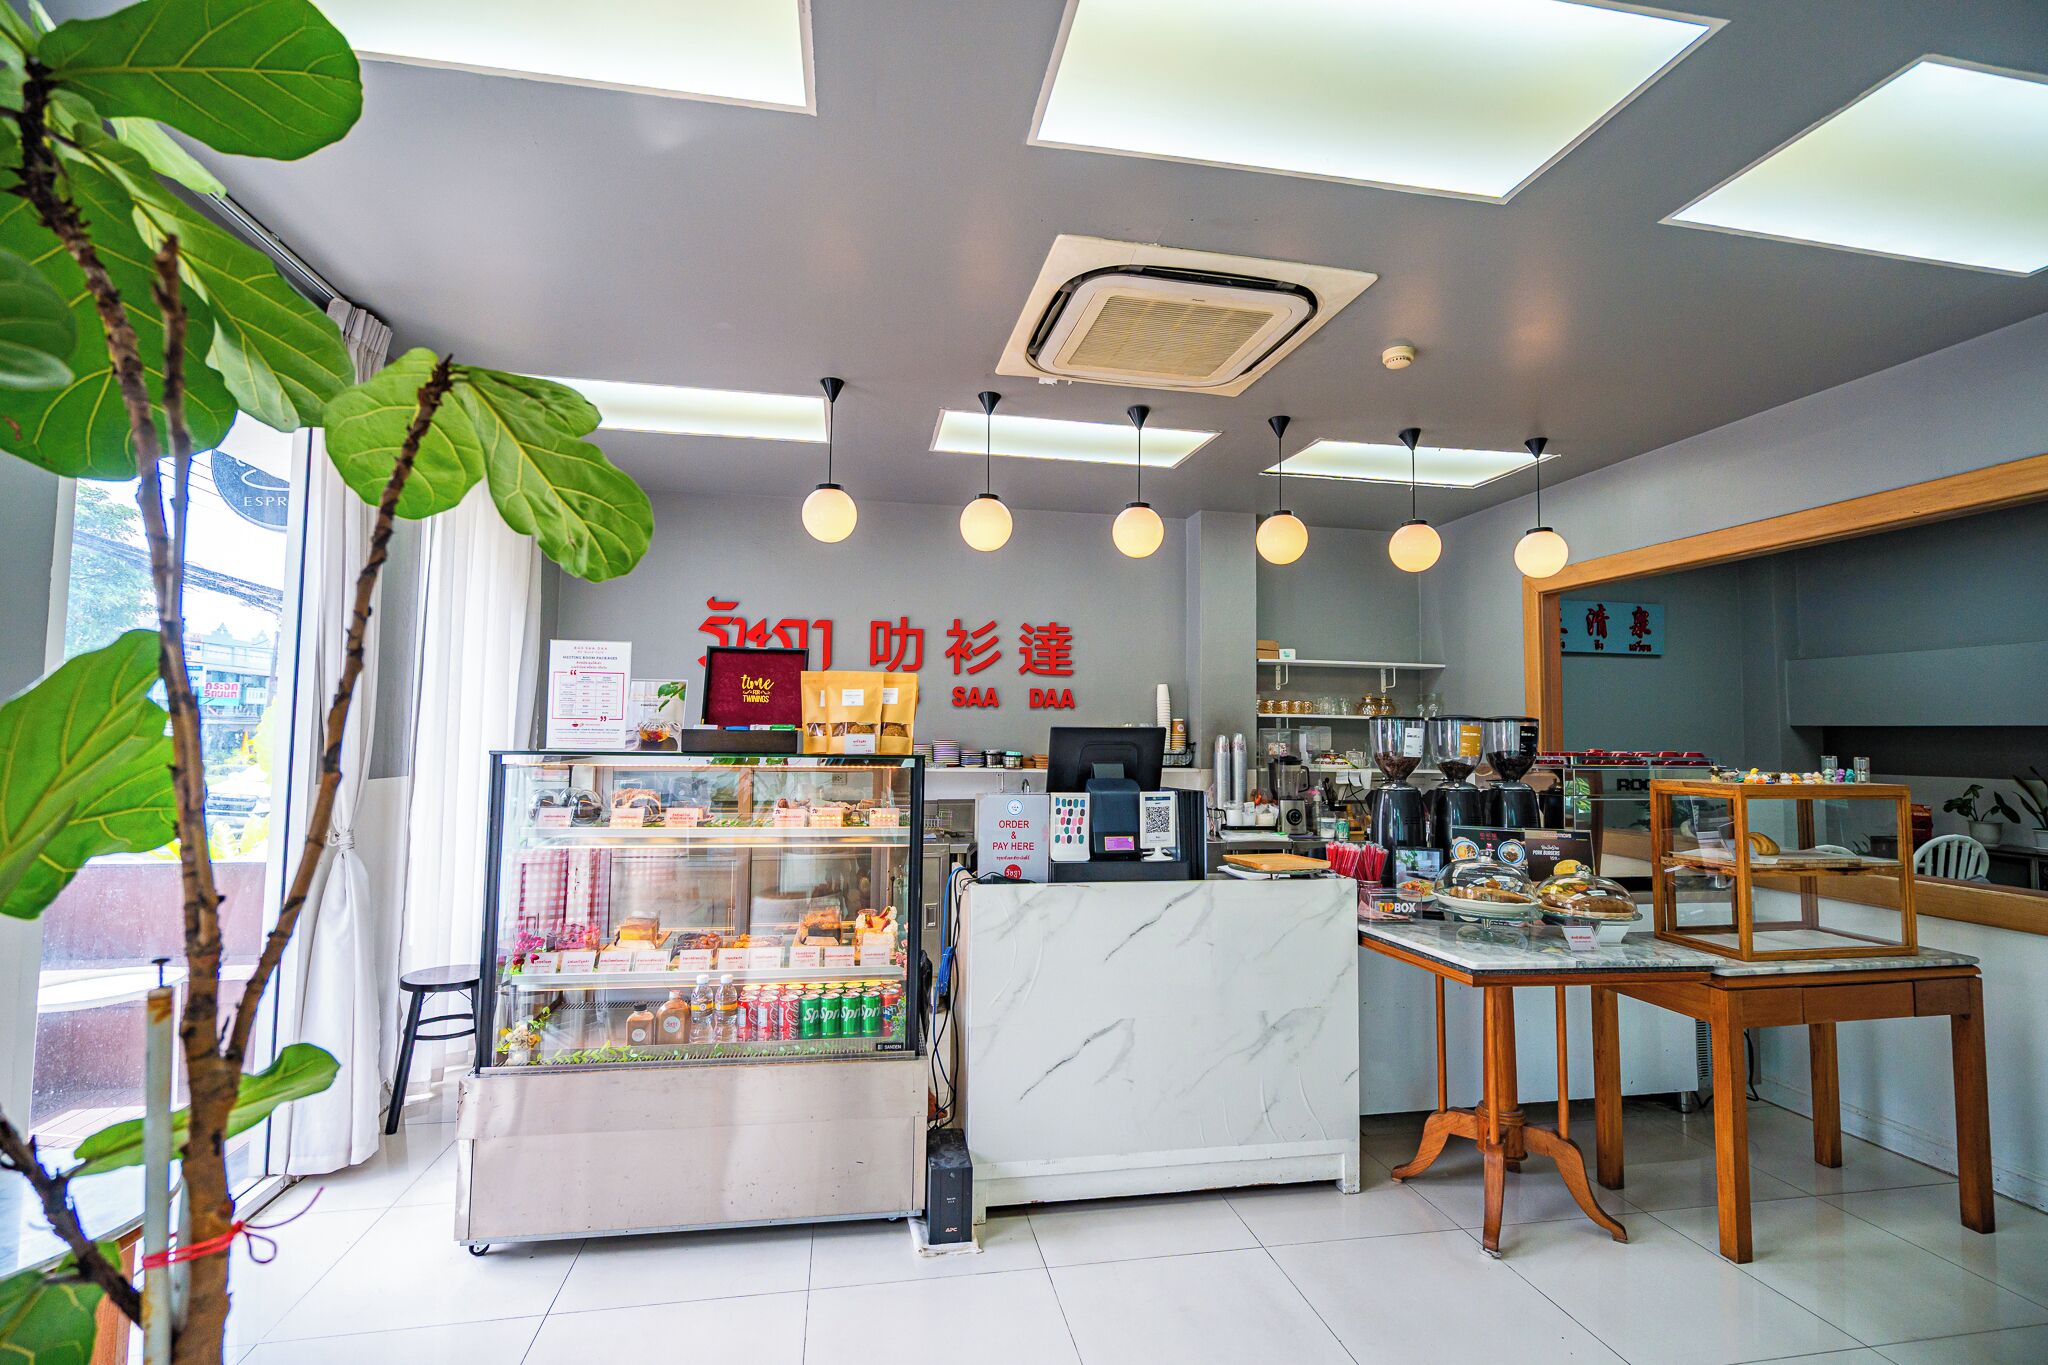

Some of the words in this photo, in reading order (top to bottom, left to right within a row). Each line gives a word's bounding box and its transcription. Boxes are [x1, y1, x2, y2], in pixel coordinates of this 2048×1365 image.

[244, 496, 287, 507] ESPR
[740, 674, 775, 690] time
[951, 686, 1000, 708] SAA
[1029, 687, 1076, 709] DAA
[998, 819, 1030, 829] ORDER
[1010, 830, 1017, 840] &
[992, 841, 1009, 850] PAY
[1010, 841, 1035, 851] HERE
